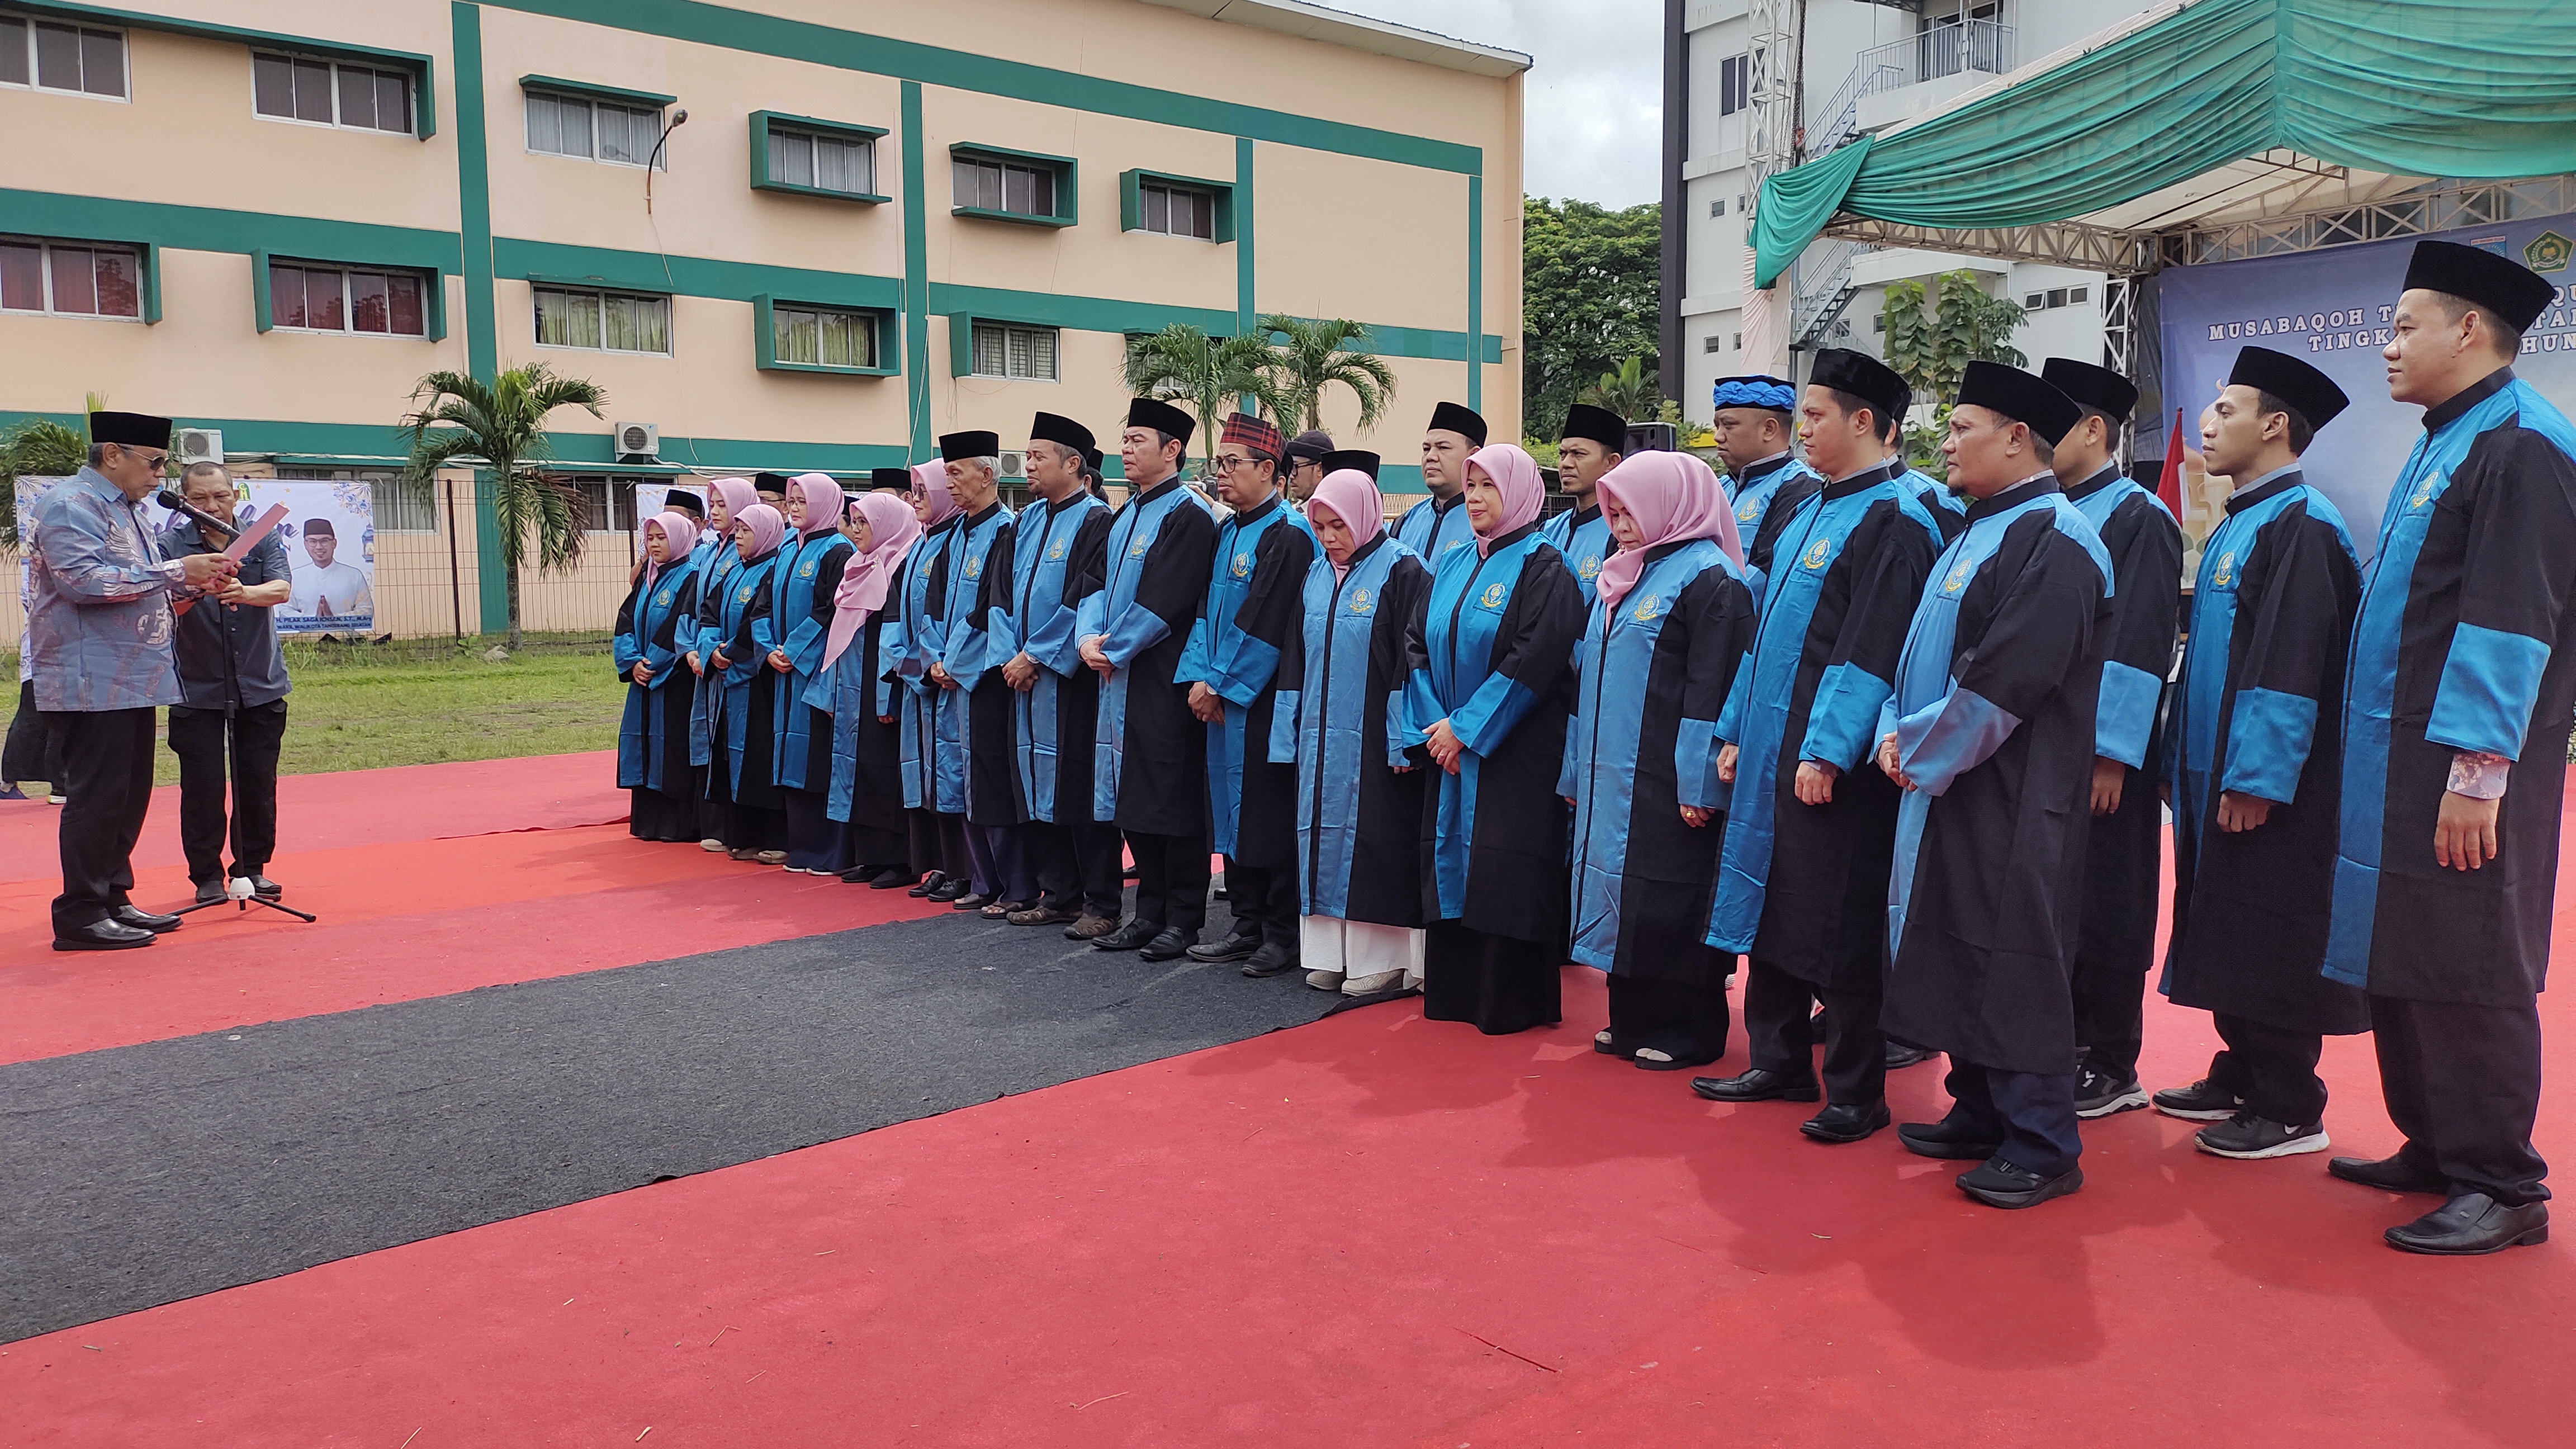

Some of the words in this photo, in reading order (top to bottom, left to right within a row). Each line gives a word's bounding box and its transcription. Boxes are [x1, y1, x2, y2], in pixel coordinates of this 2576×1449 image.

[2209, 308, 2364, 340] MUSABAQOH
[2308, 328, 2390, 352] TINGK
[2520, 332, 2576, 354] HUN
